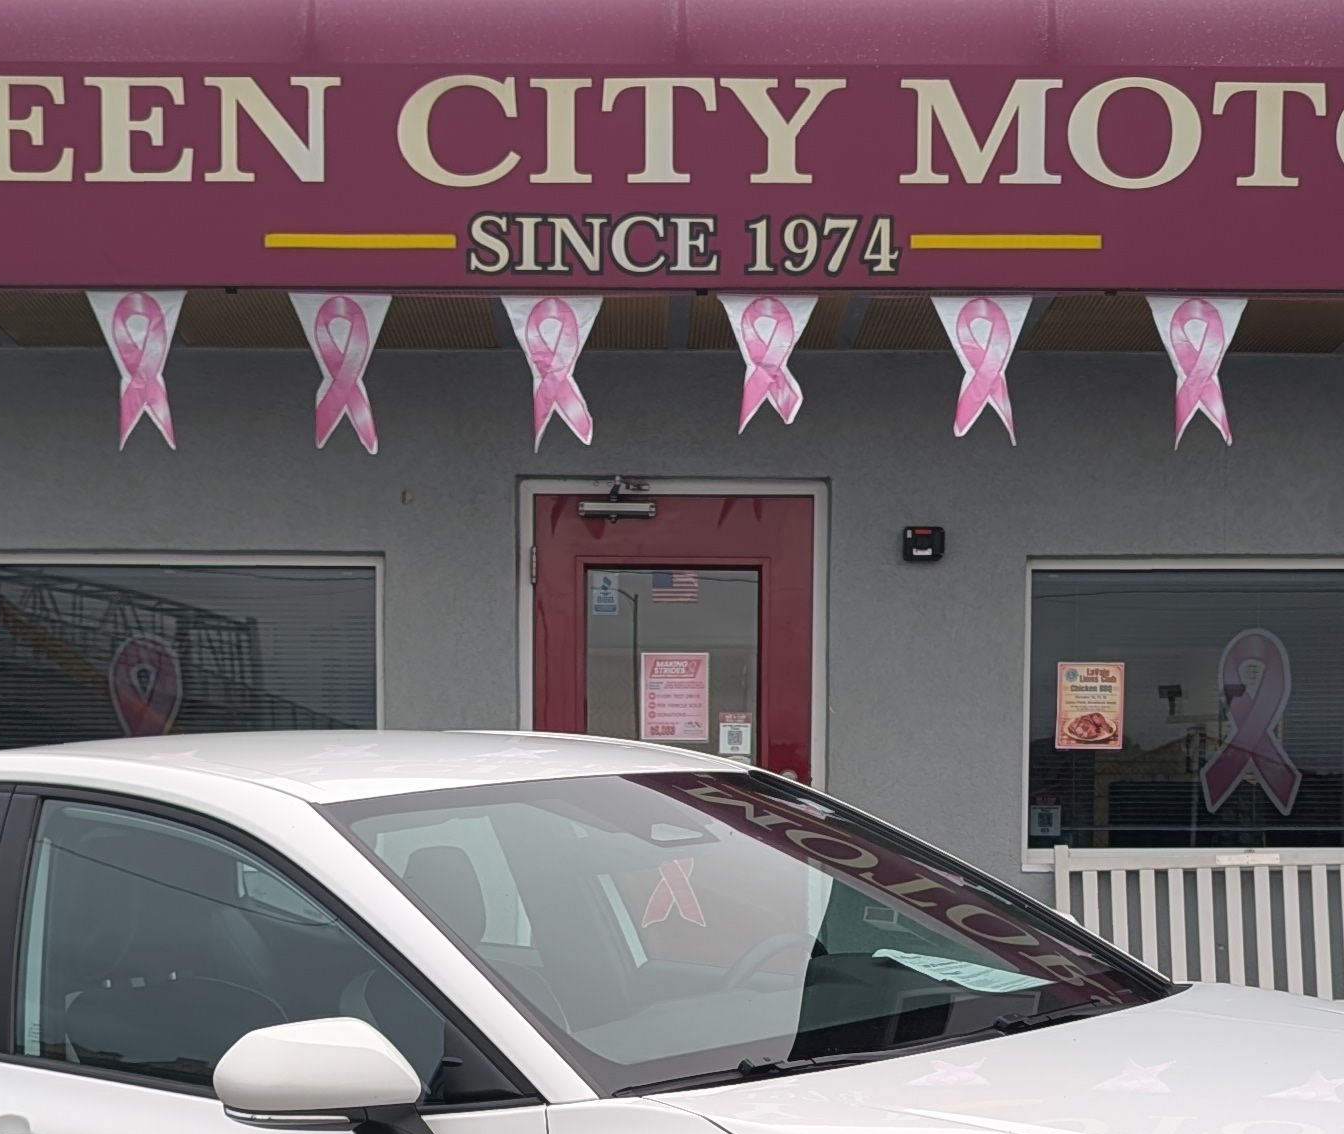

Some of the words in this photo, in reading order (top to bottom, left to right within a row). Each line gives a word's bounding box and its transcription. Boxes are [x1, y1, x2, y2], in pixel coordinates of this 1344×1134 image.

[396, 74, 847, 188] CITY
[467, 213, 718, 275] SINCE
[745, 214, 900, 276] 1974
